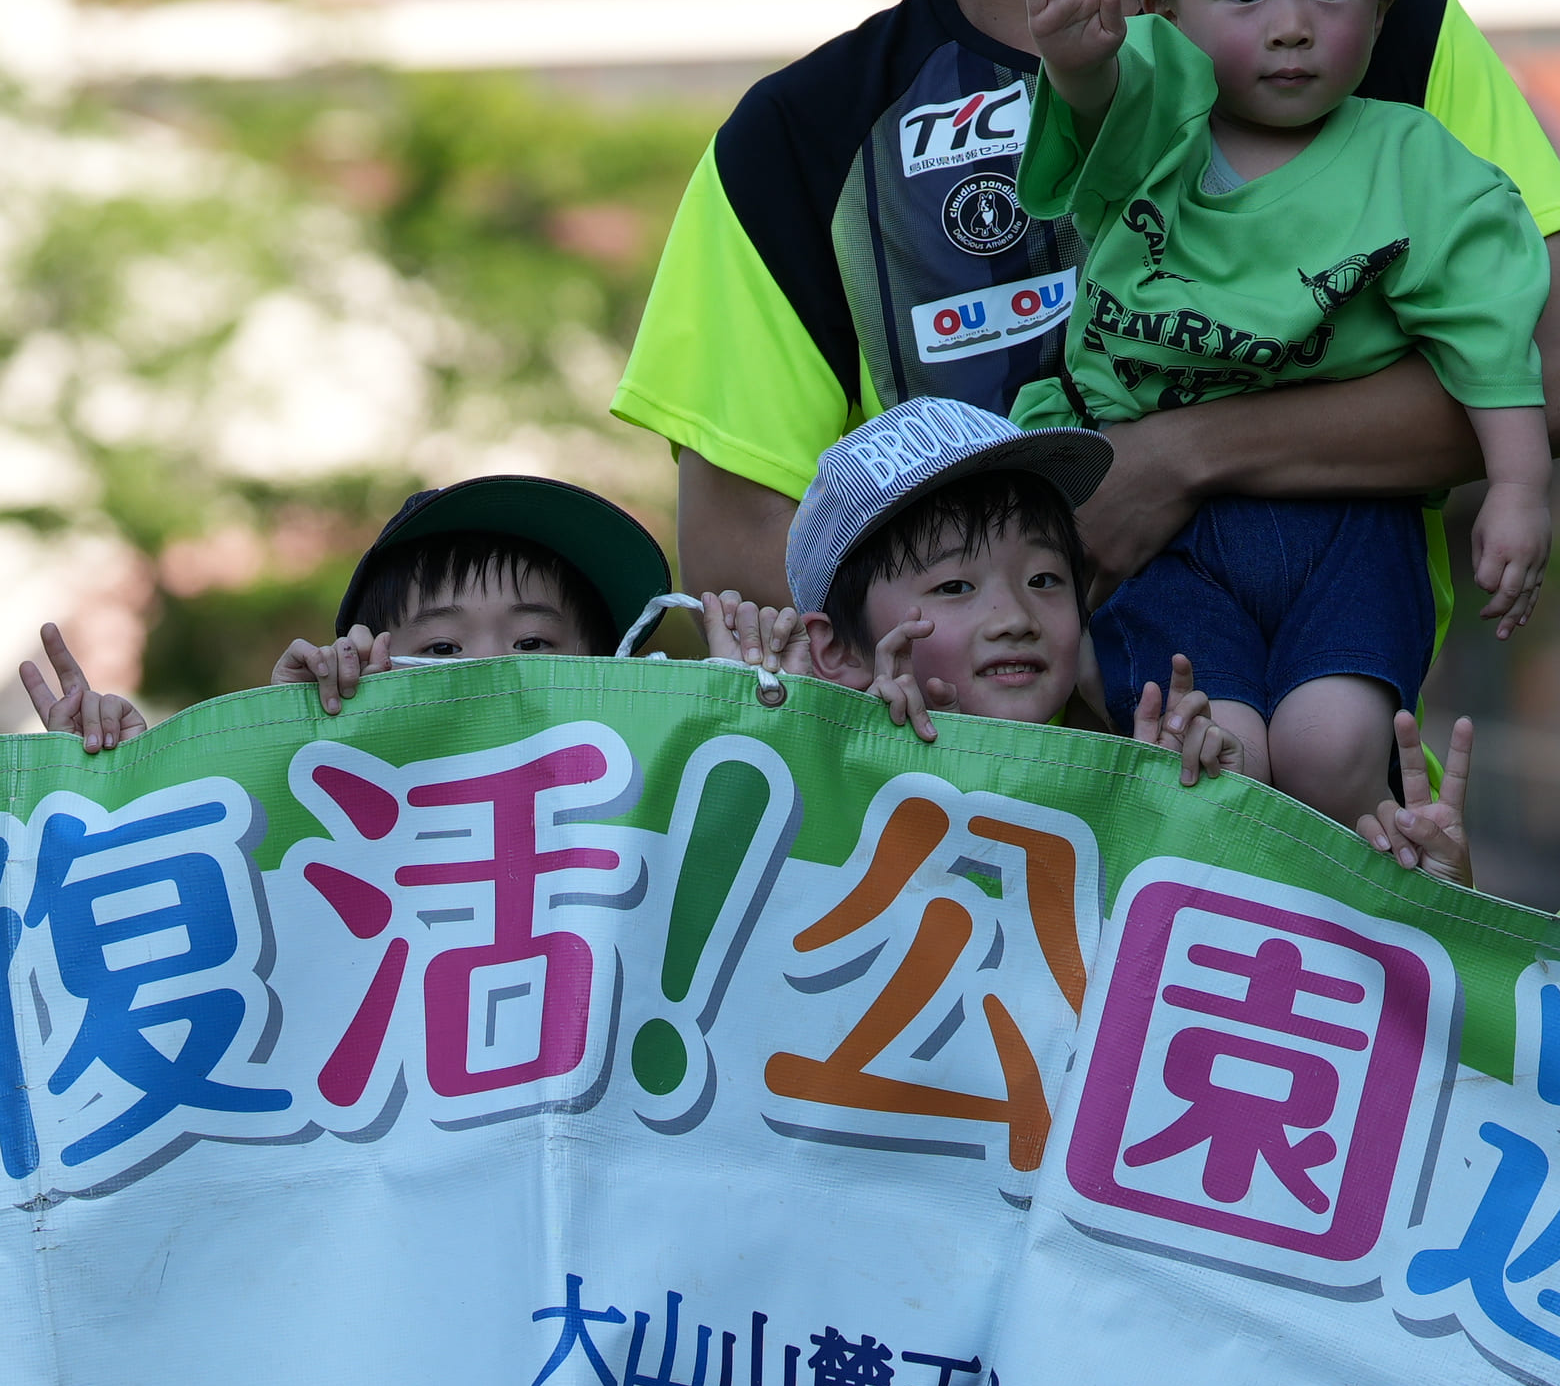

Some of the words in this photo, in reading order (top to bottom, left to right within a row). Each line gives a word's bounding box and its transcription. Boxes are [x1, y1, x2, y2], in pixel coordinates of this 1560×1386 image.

[949, 182, 977, 218] claudio
[933, 301, 986, 336] OU
[1011, 282, 1064, 317] OU
[1086, 279, 1334, 374] ENRYOU
